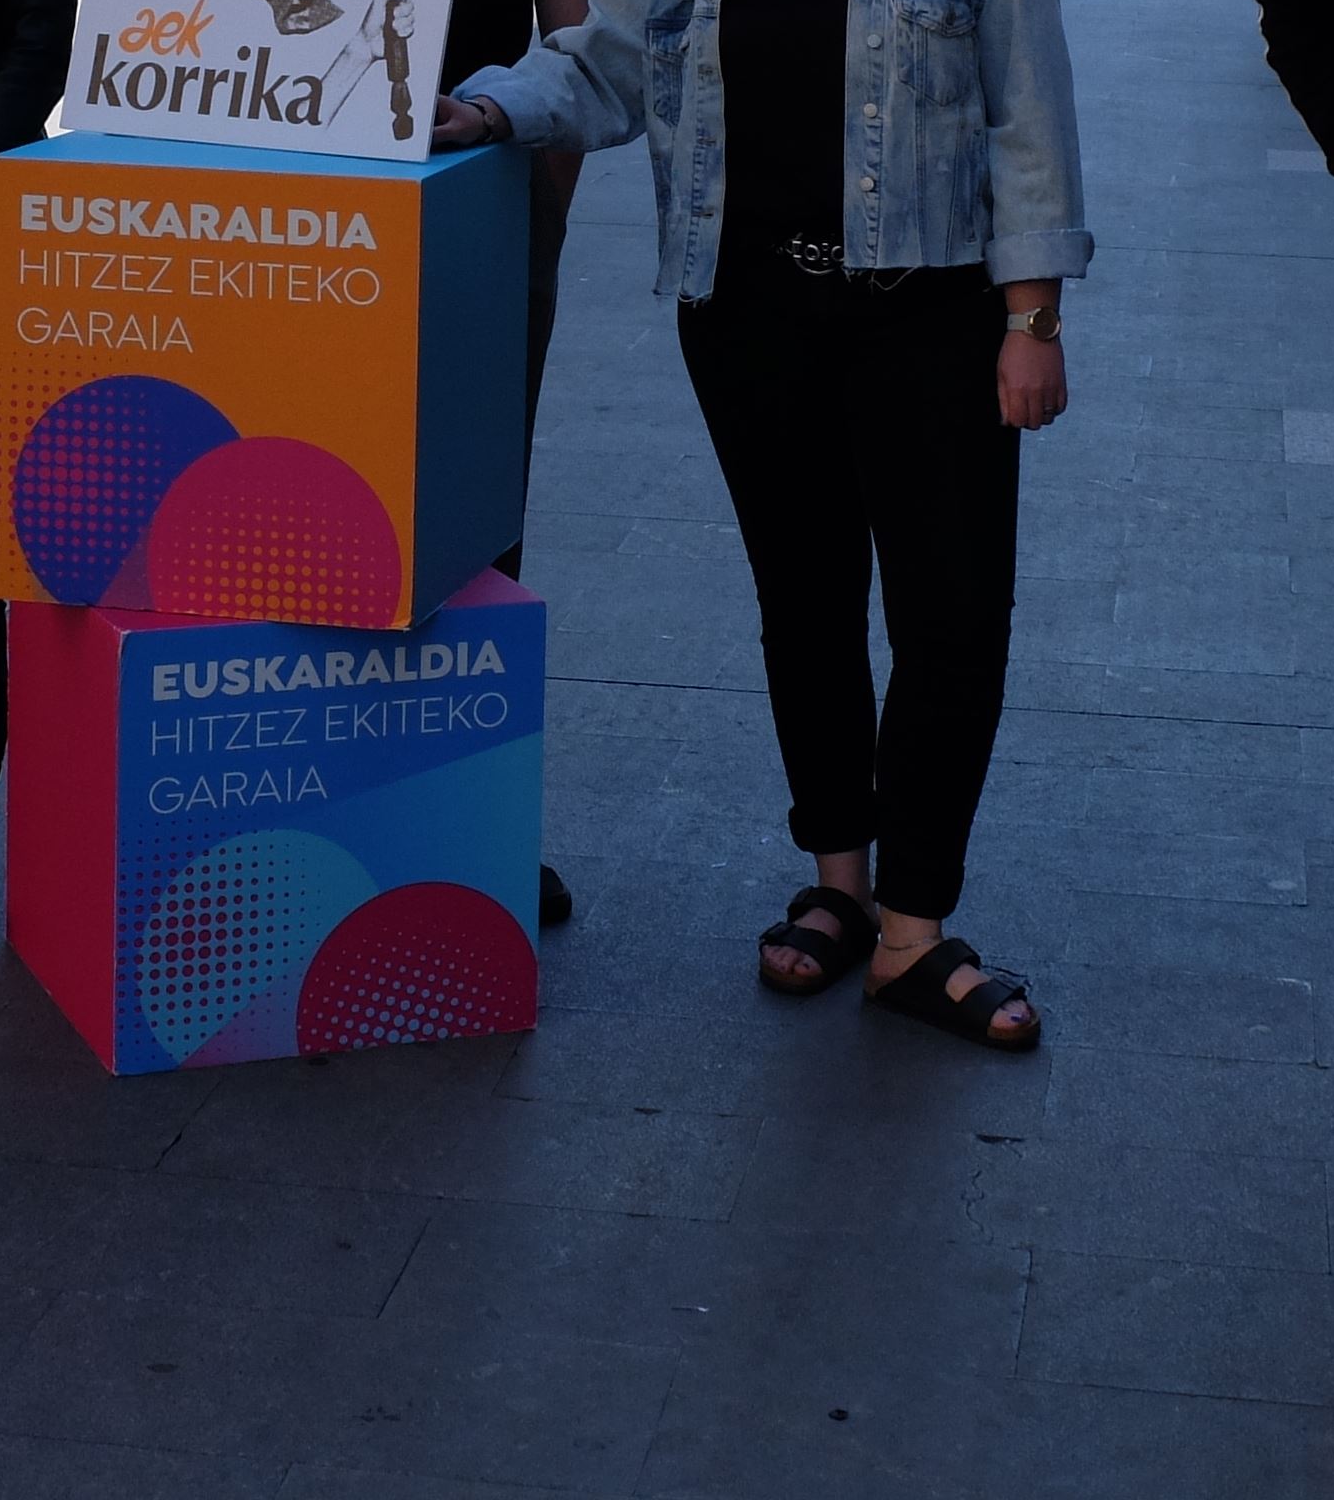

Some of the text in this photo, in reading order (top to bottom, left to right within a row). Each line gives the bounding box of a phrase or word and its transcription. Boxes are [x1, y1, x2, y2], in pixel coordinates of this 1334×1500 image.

[85, 33, 323, 127] korrika
[19, 193, 378, 250] EUSKARALDIA
[18, 249, 381, 306] HITZEZ EKITEKO
[16, 307, 194, 354] GARAIA
[152, 639, 506, 702] EUSKARALDIA
[150, 691, 509, 757] HITZEZ EKITEKO
[148, 764, 329, 816] GARAIA
